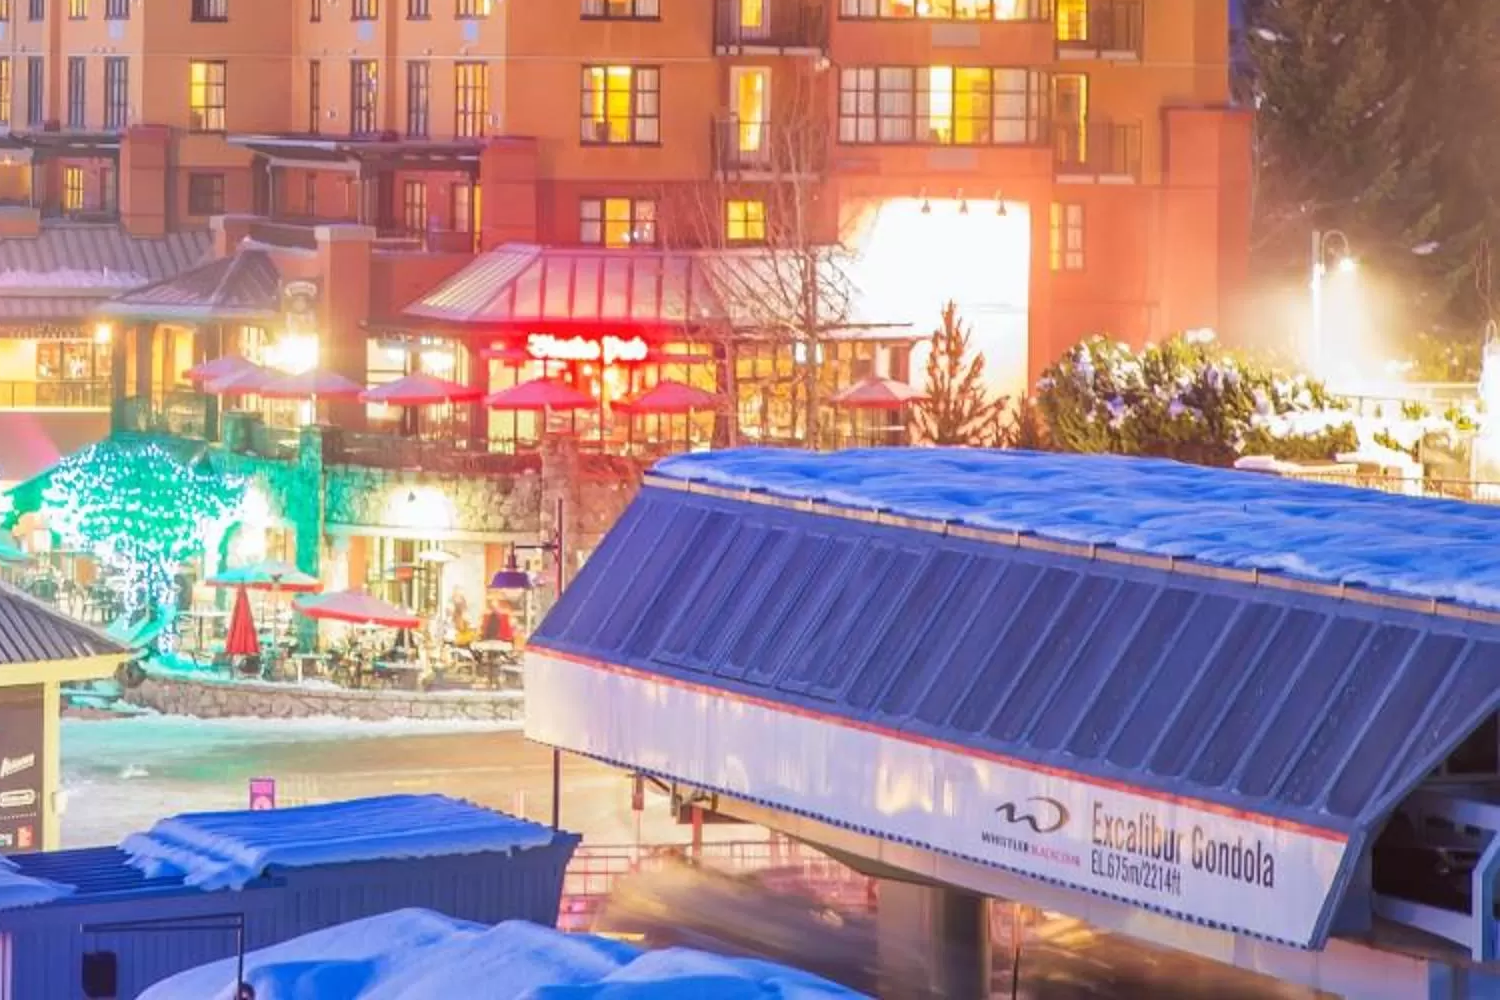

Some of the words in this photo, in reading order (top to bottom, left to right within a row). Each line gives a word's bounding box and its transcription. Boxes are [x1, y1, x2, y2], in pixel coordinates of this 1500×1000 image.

[981, 831, 1029, 852] WHISTLER
[1092, 801, 1184, 865] Excalibur
[1191, 825, 1275, 888] Gondola
